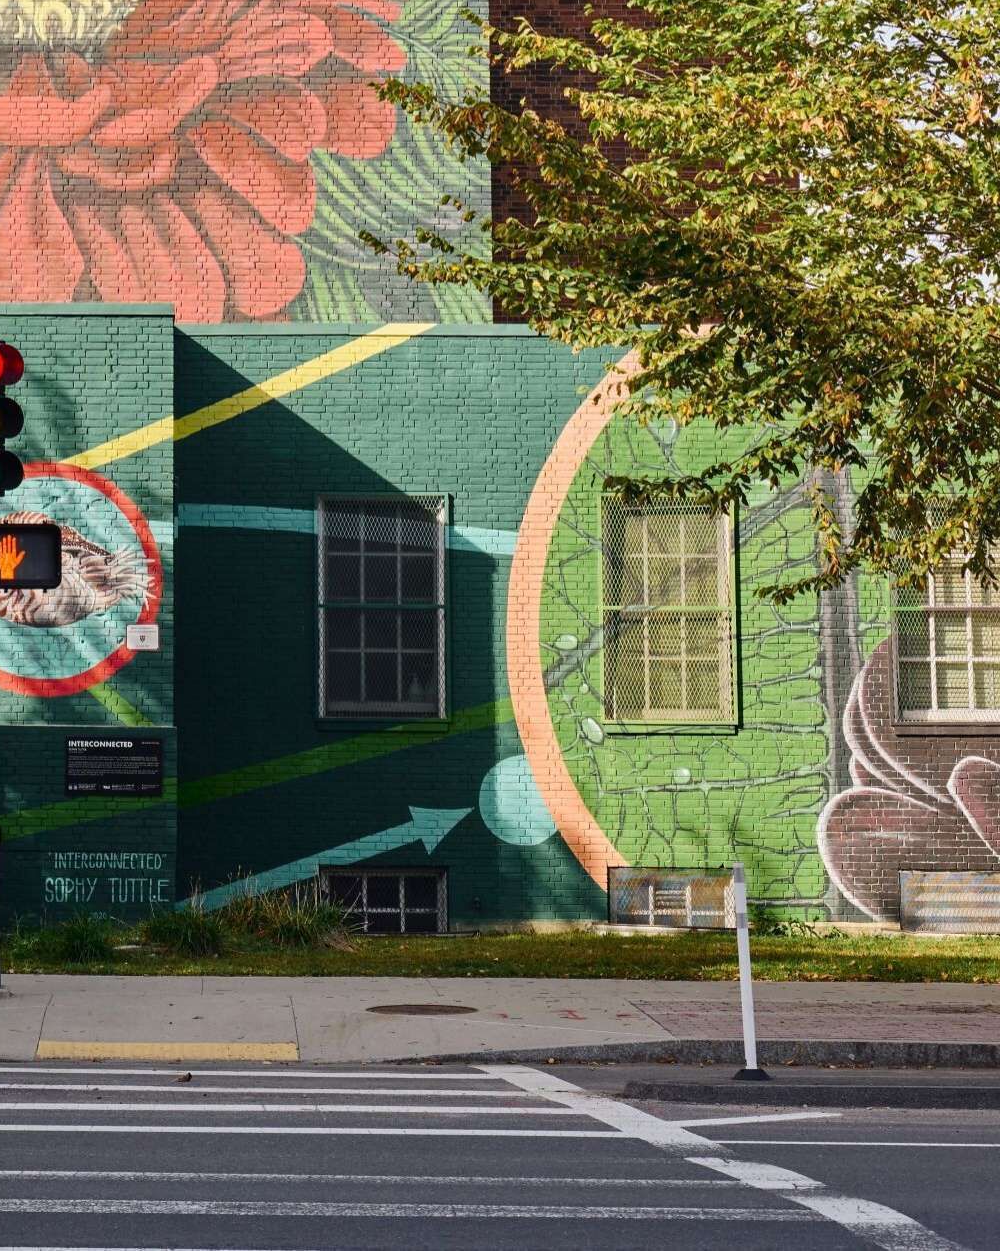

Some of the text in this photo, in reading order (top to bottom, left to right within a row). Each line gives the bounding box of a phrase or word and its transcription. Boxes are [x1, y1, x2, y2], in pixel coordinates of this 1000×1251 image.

[68, 740, 134, 748] INTERCONNECTED
[44, 877, 170, 903] SOPHY TUTTLE
